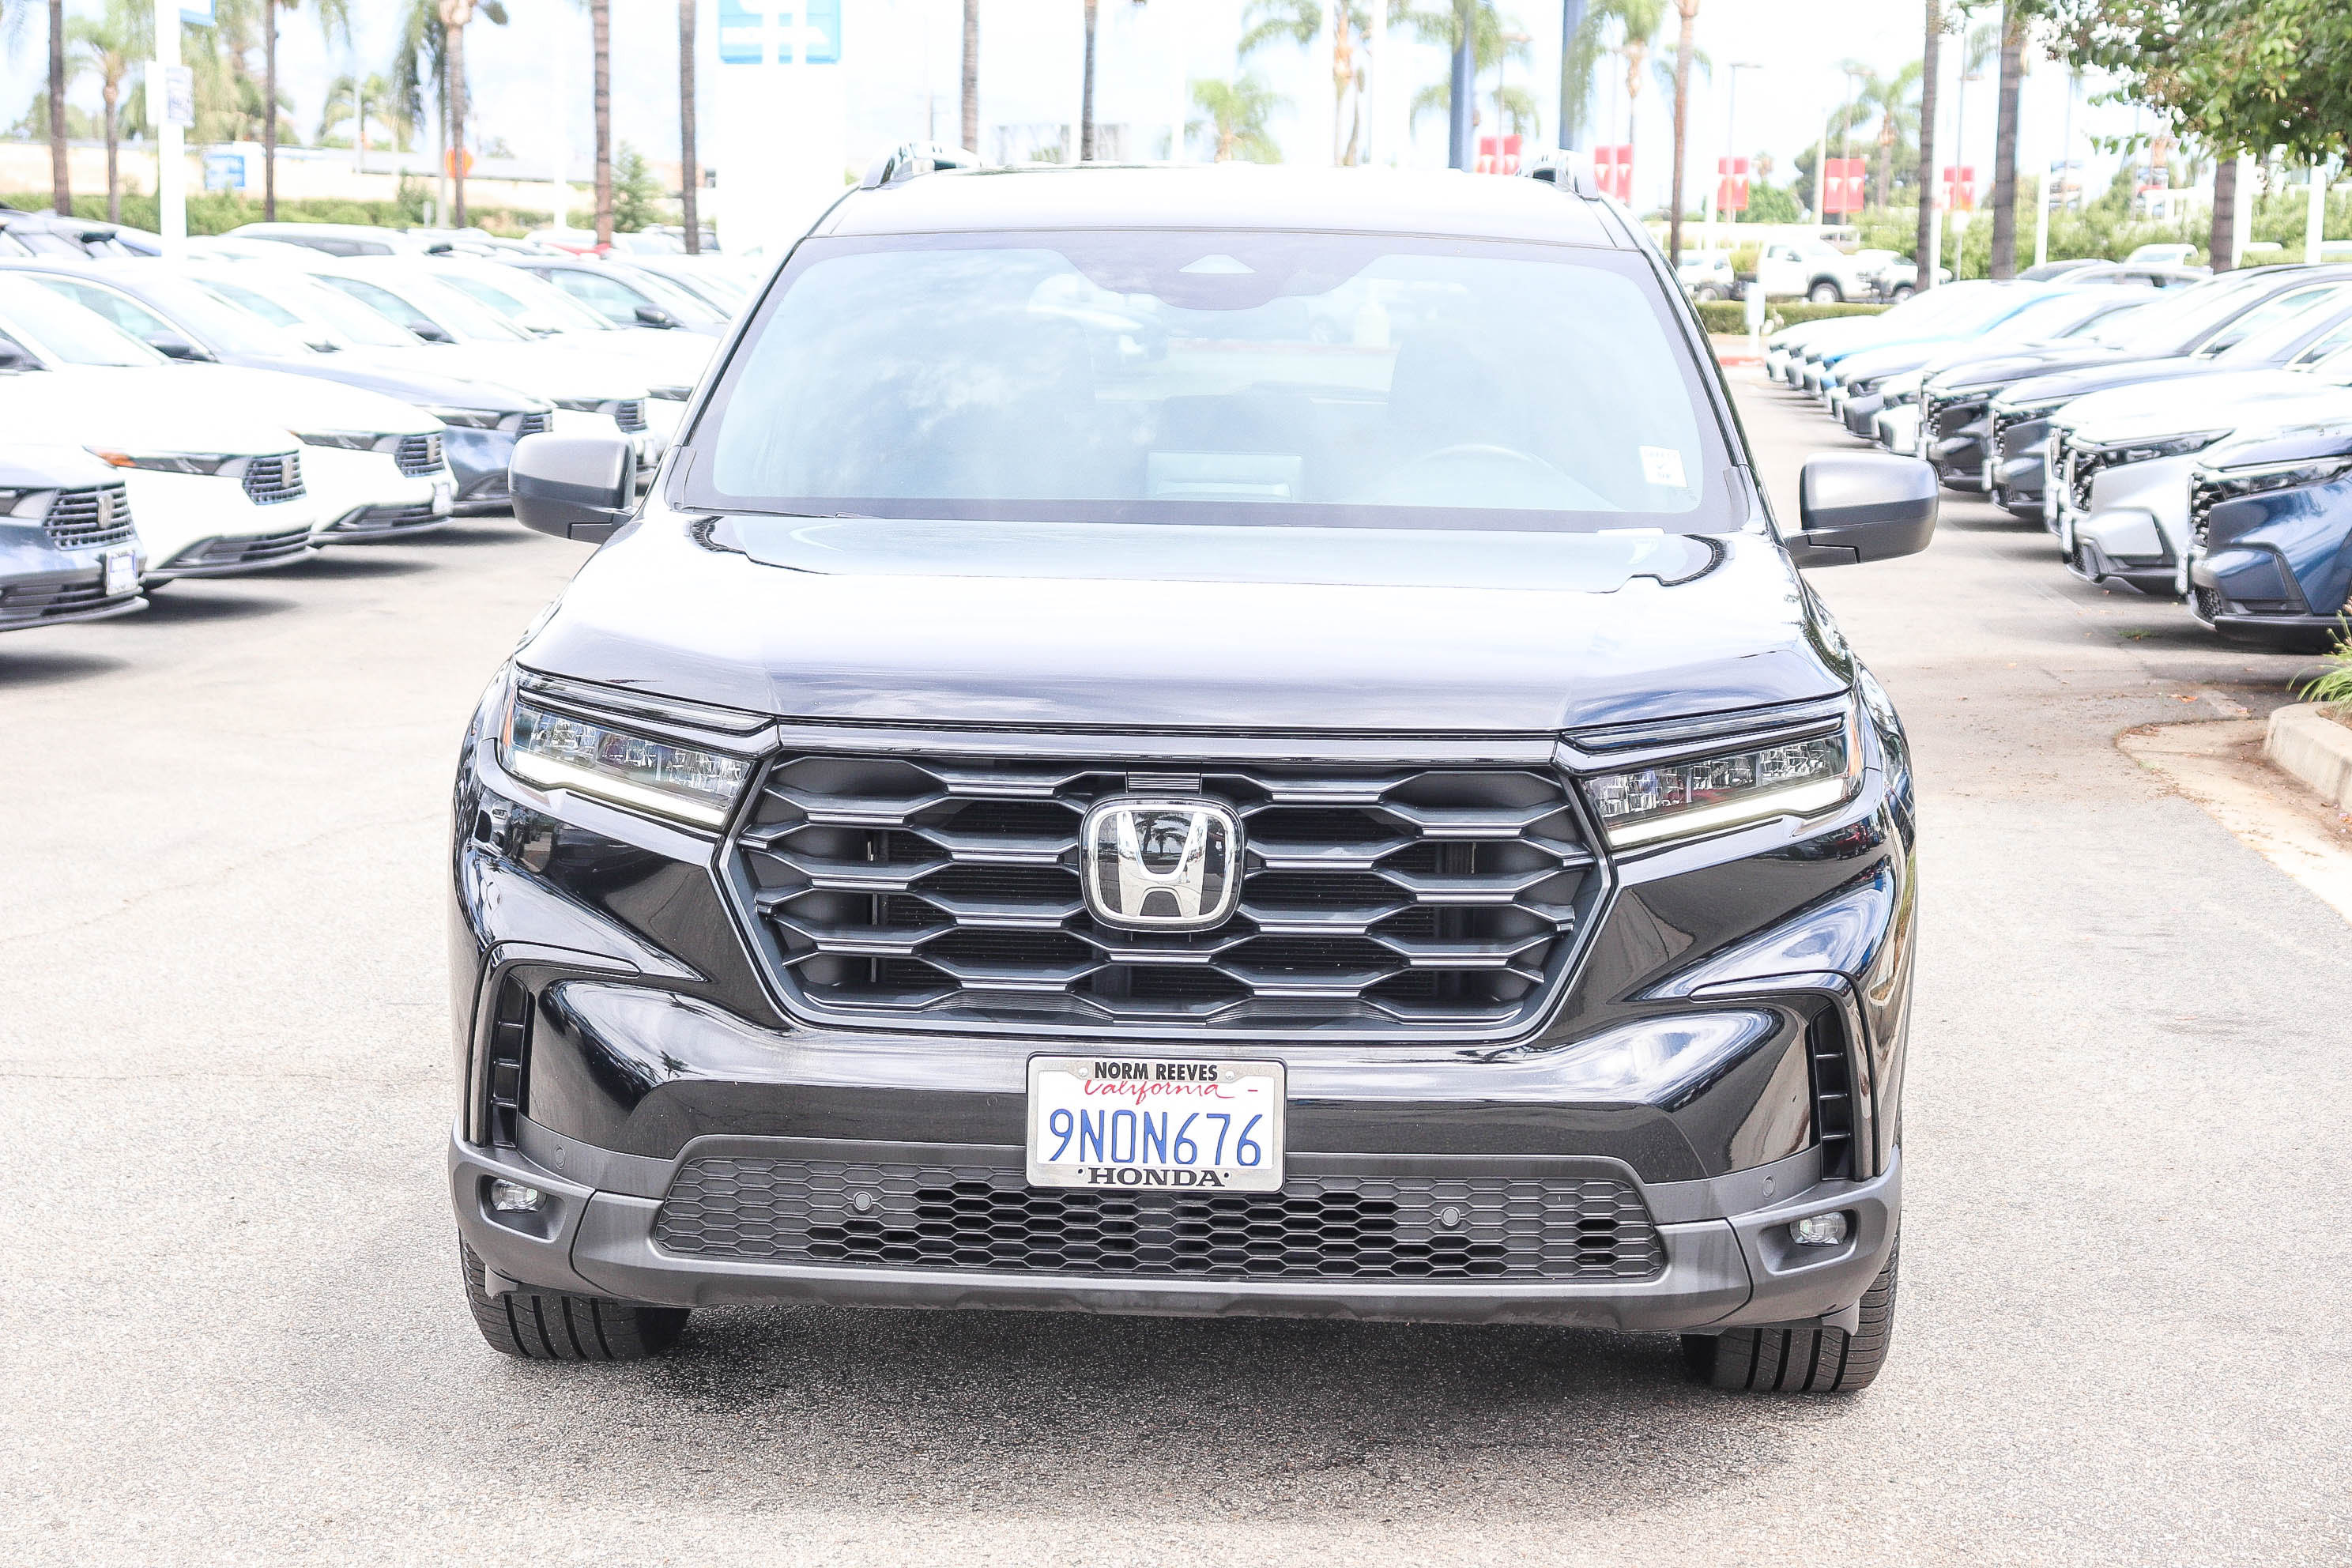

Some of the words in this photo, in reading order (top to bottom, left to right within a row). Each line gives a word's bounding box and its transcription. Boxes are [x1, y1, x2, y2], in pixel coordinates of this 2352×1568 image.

[1095, 1061, 1149, 1080] NORM
[1155, 1064, 1218, 1081] REEVES
[1084, 1080, 1235, 1105] California
[1049, 1108, 1263, 1166] 9NON676
[1087, 1167, 1226, 1187] HONDA
